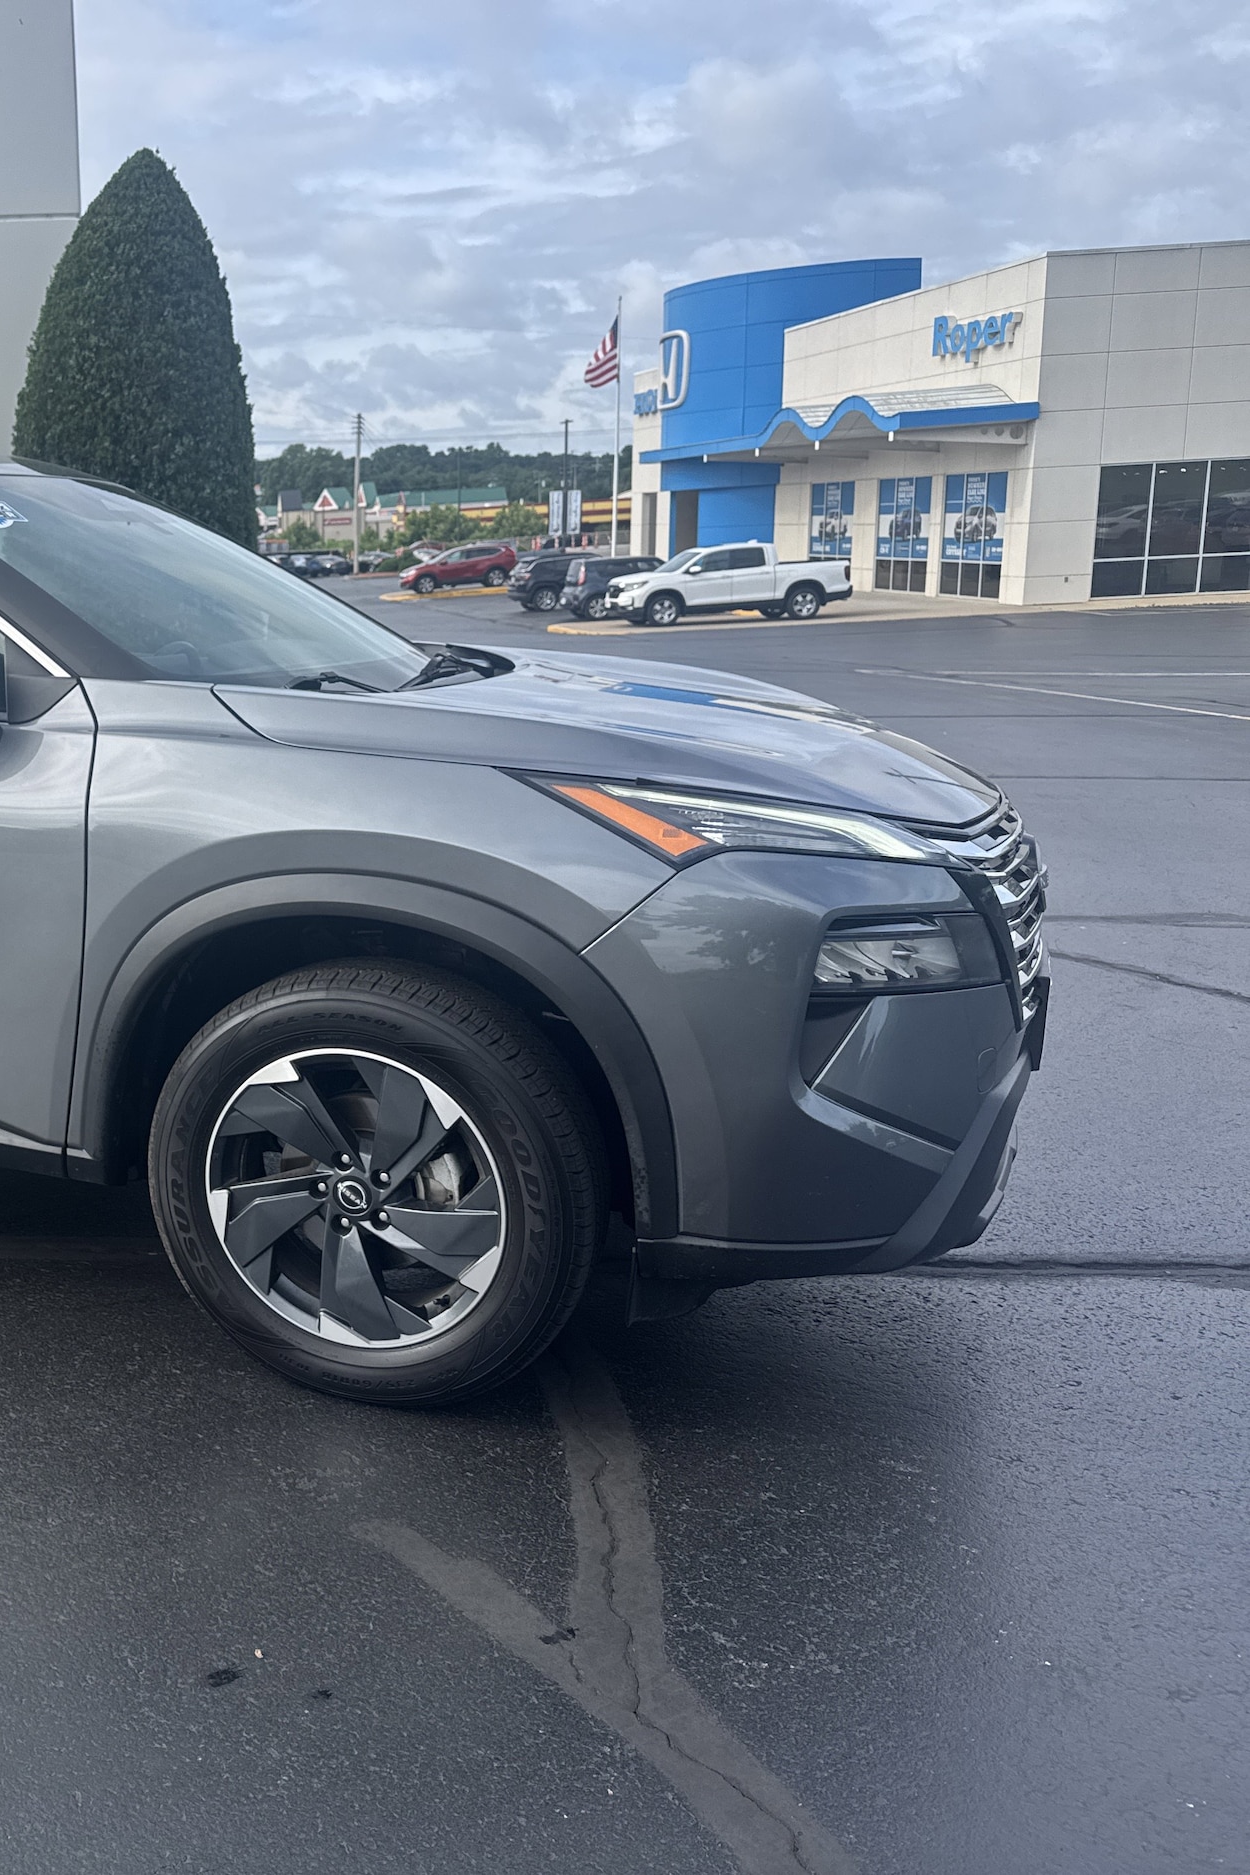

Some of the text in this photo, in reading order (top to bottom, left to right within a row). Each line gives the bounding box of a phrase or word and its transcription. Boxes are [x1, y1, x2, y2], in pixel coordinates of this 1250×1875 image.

[932, 312, 1016, 363] Roper
[257, 1012, 405, 1034] ALL-SEASON
[168, 1064, 236, 1315] ASSURANCE
[337, 1182, 368, 1209] NISSAN
[469, 1080, 547, 1339] GOODYEAR
